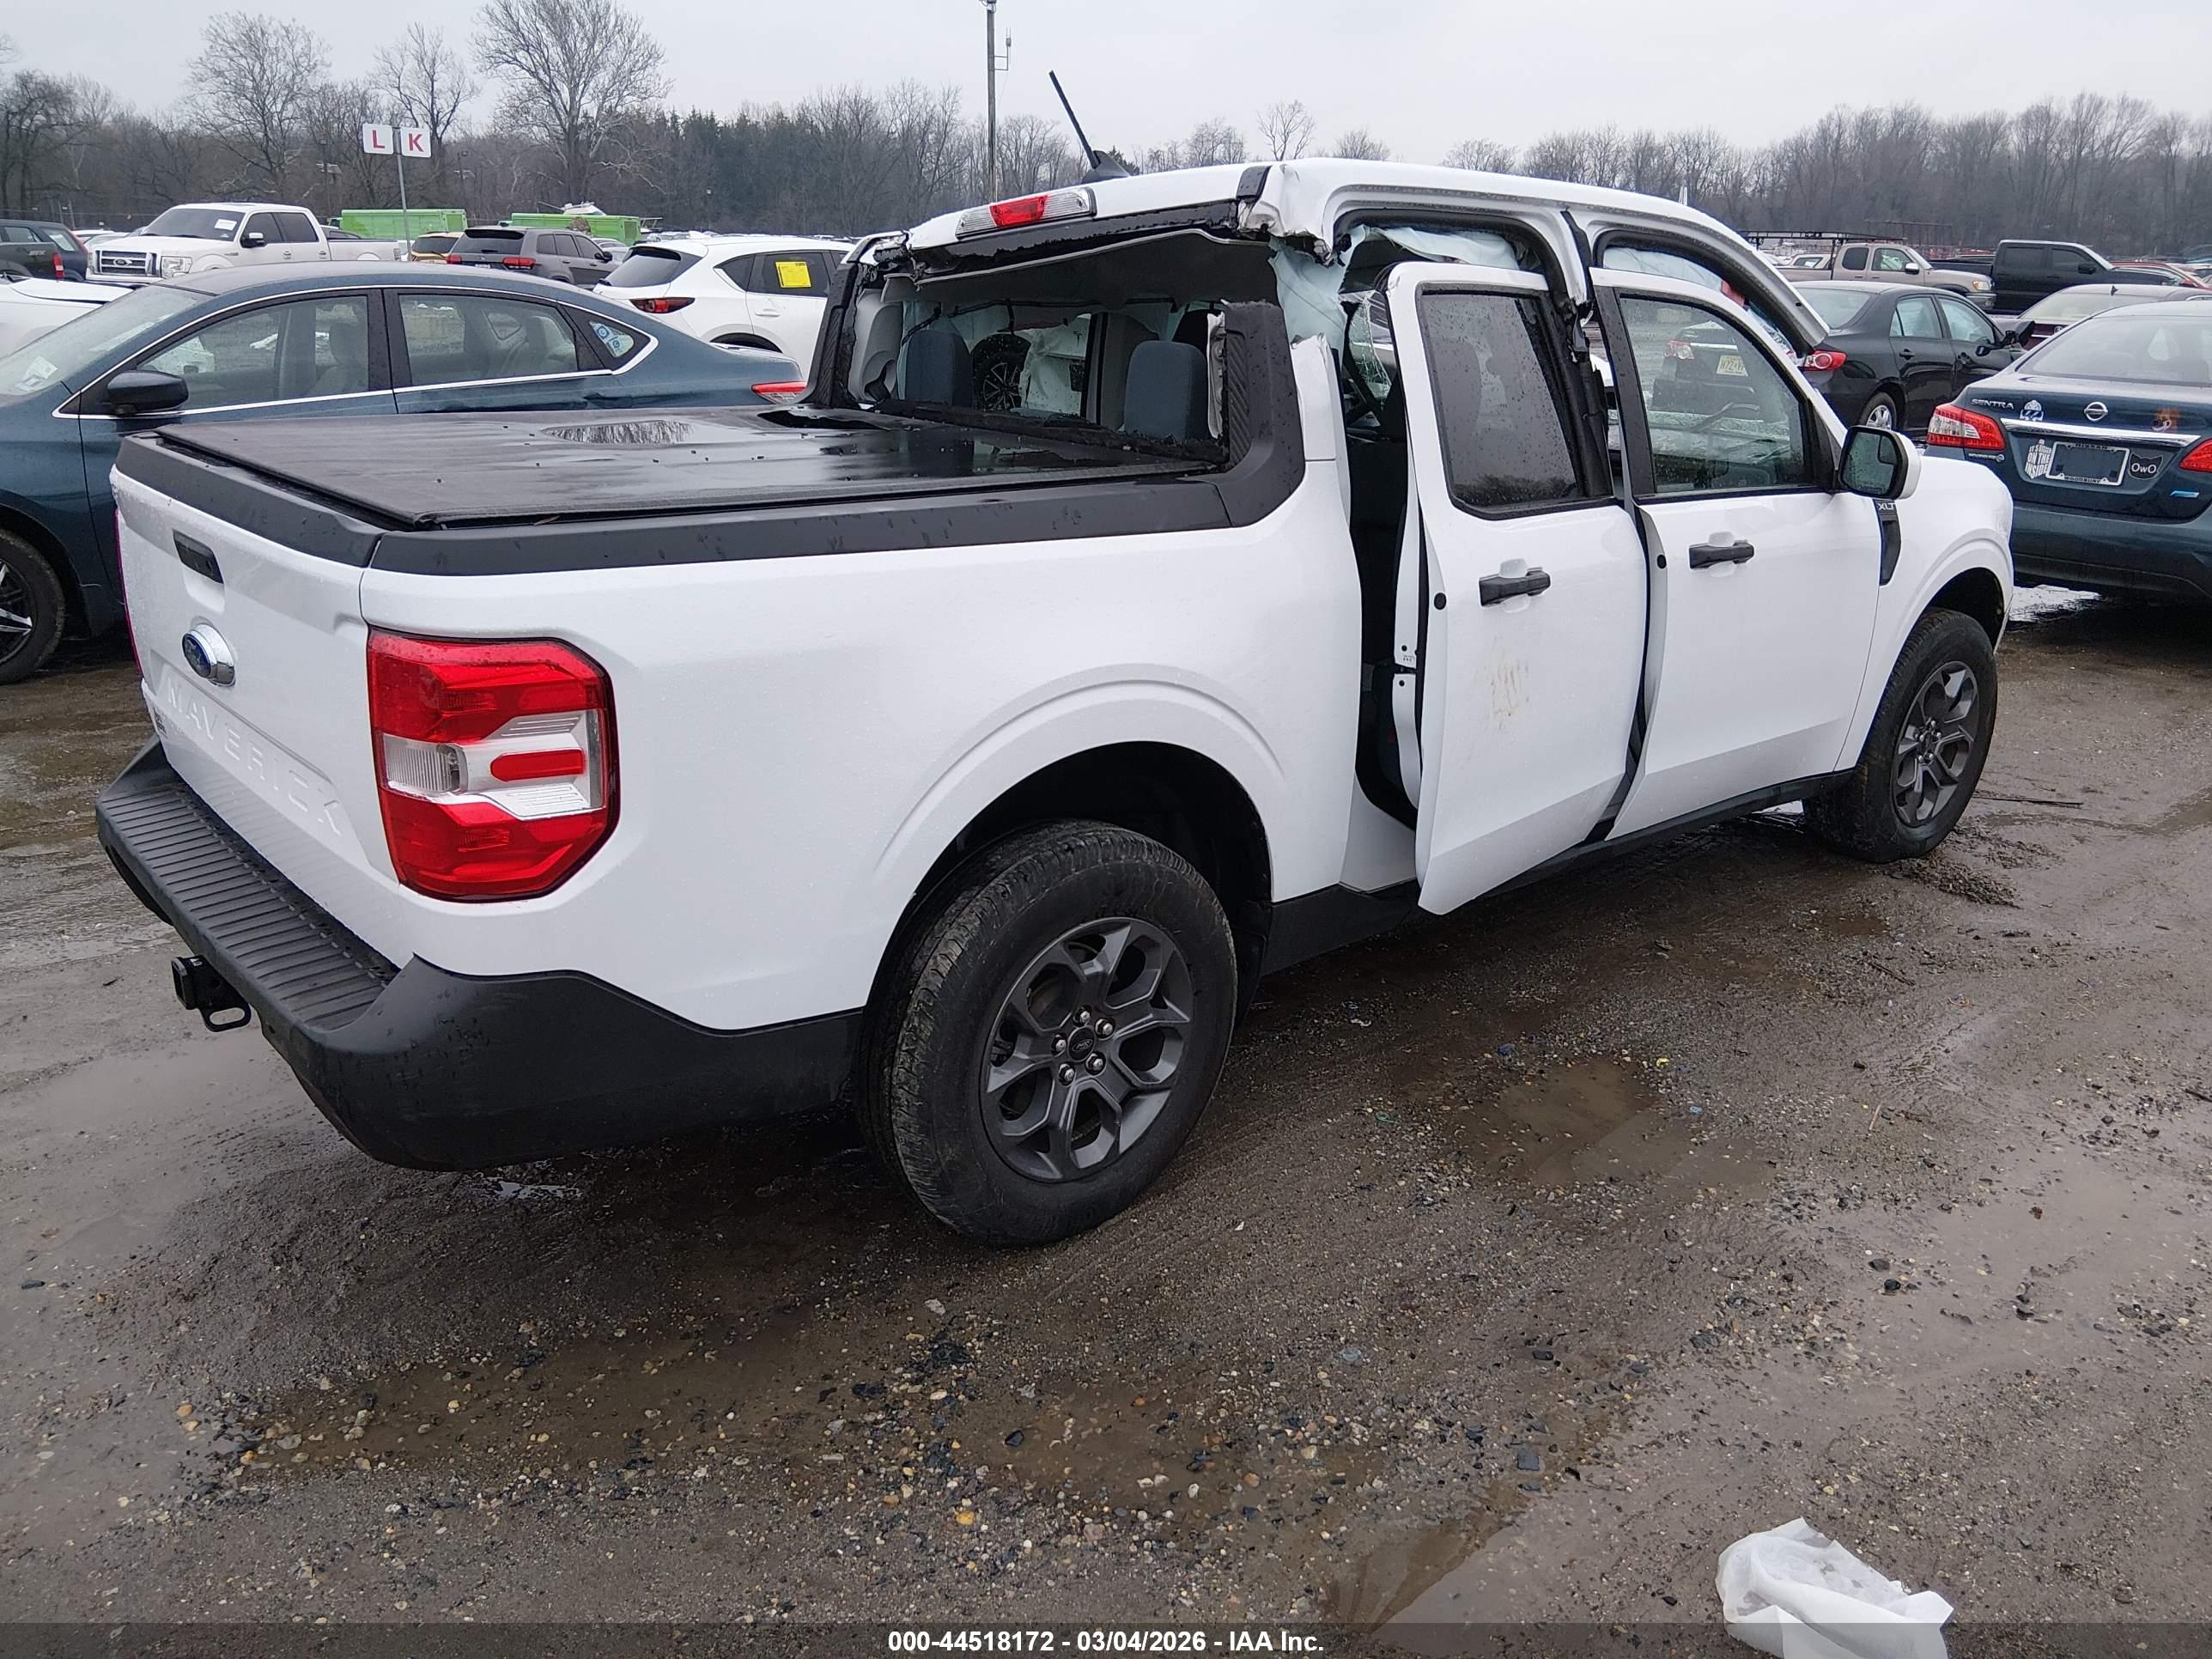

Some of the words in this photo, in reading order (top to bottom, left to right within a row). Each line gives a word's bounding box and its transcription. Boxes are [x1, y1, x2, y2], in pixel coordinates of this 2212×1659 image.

[372, 130, 386, 149] L
[408, 132, 425, 153] K
[1972, 398, 2014, 410] SENTRA
[2027, 452, 2038, 465] ON
[2037, 452, 2051, 465] THE
[2024, 461, 2049, 480] INSIDE
[1877, 502, 1896, 511] XLT
